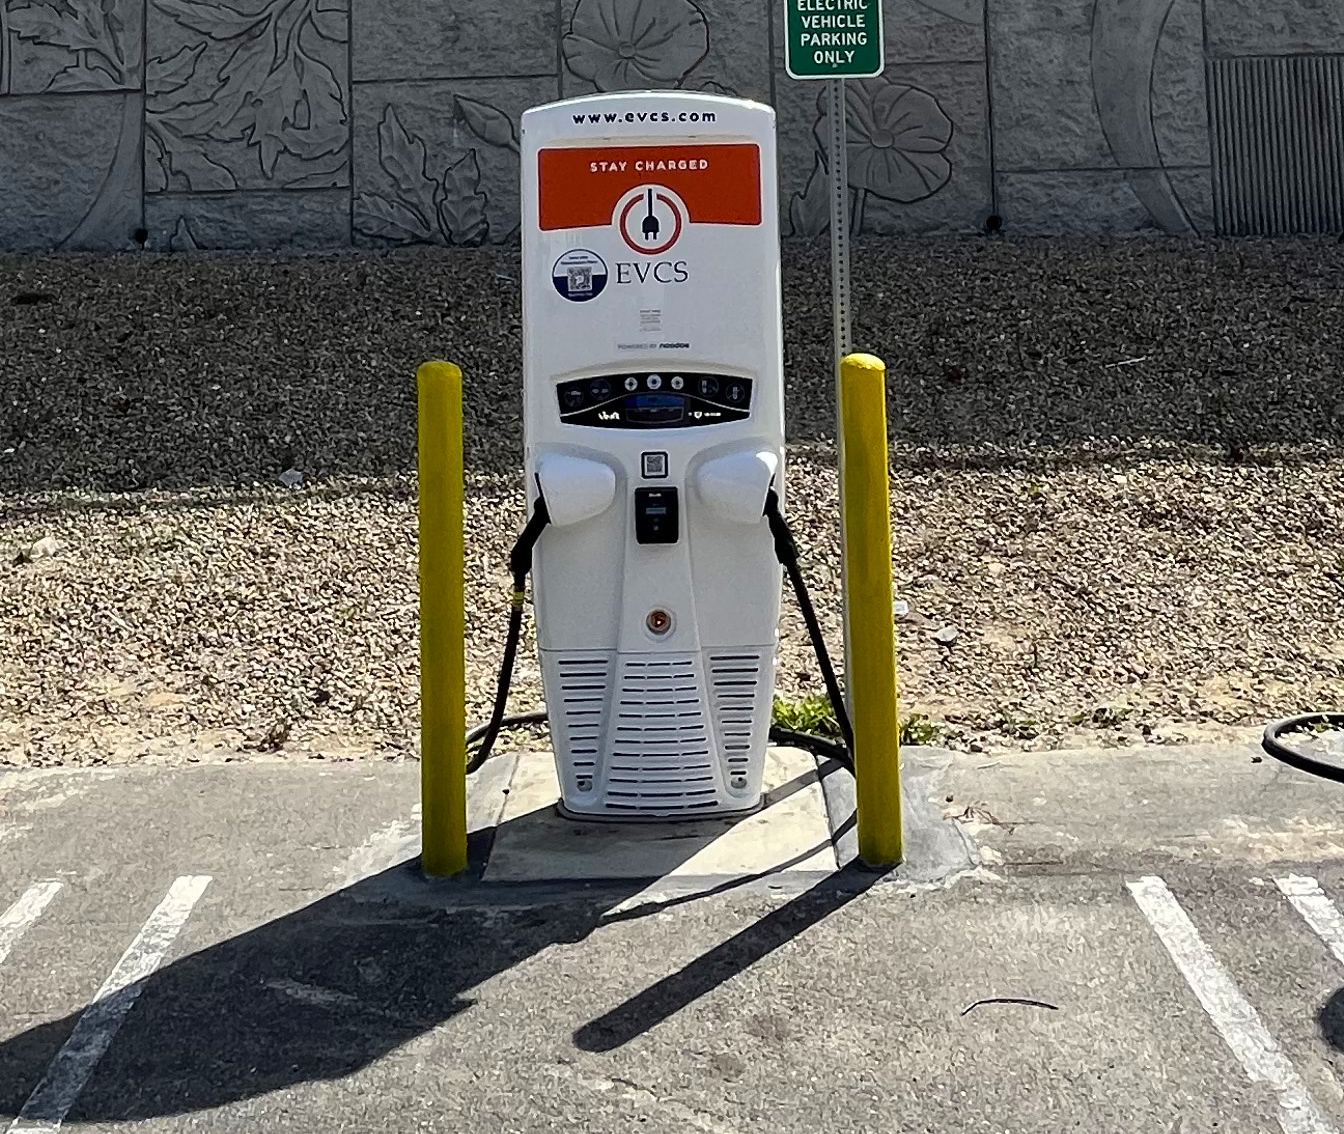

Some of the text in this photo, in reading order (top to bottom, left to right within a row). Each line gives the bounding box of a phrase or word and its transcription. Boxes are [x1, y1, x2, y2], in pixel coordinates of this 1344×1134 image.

[801, 14, 866, 29] VEHICLE
[800, 32, 867, 46] PARKING
[813, 50, 855, 64] ONLY
[572, 111, 716, 125] www.evcs.com
[590, 159, 708, 172] STAY CHARGED
[615, 260, 688, 284] EVCS
